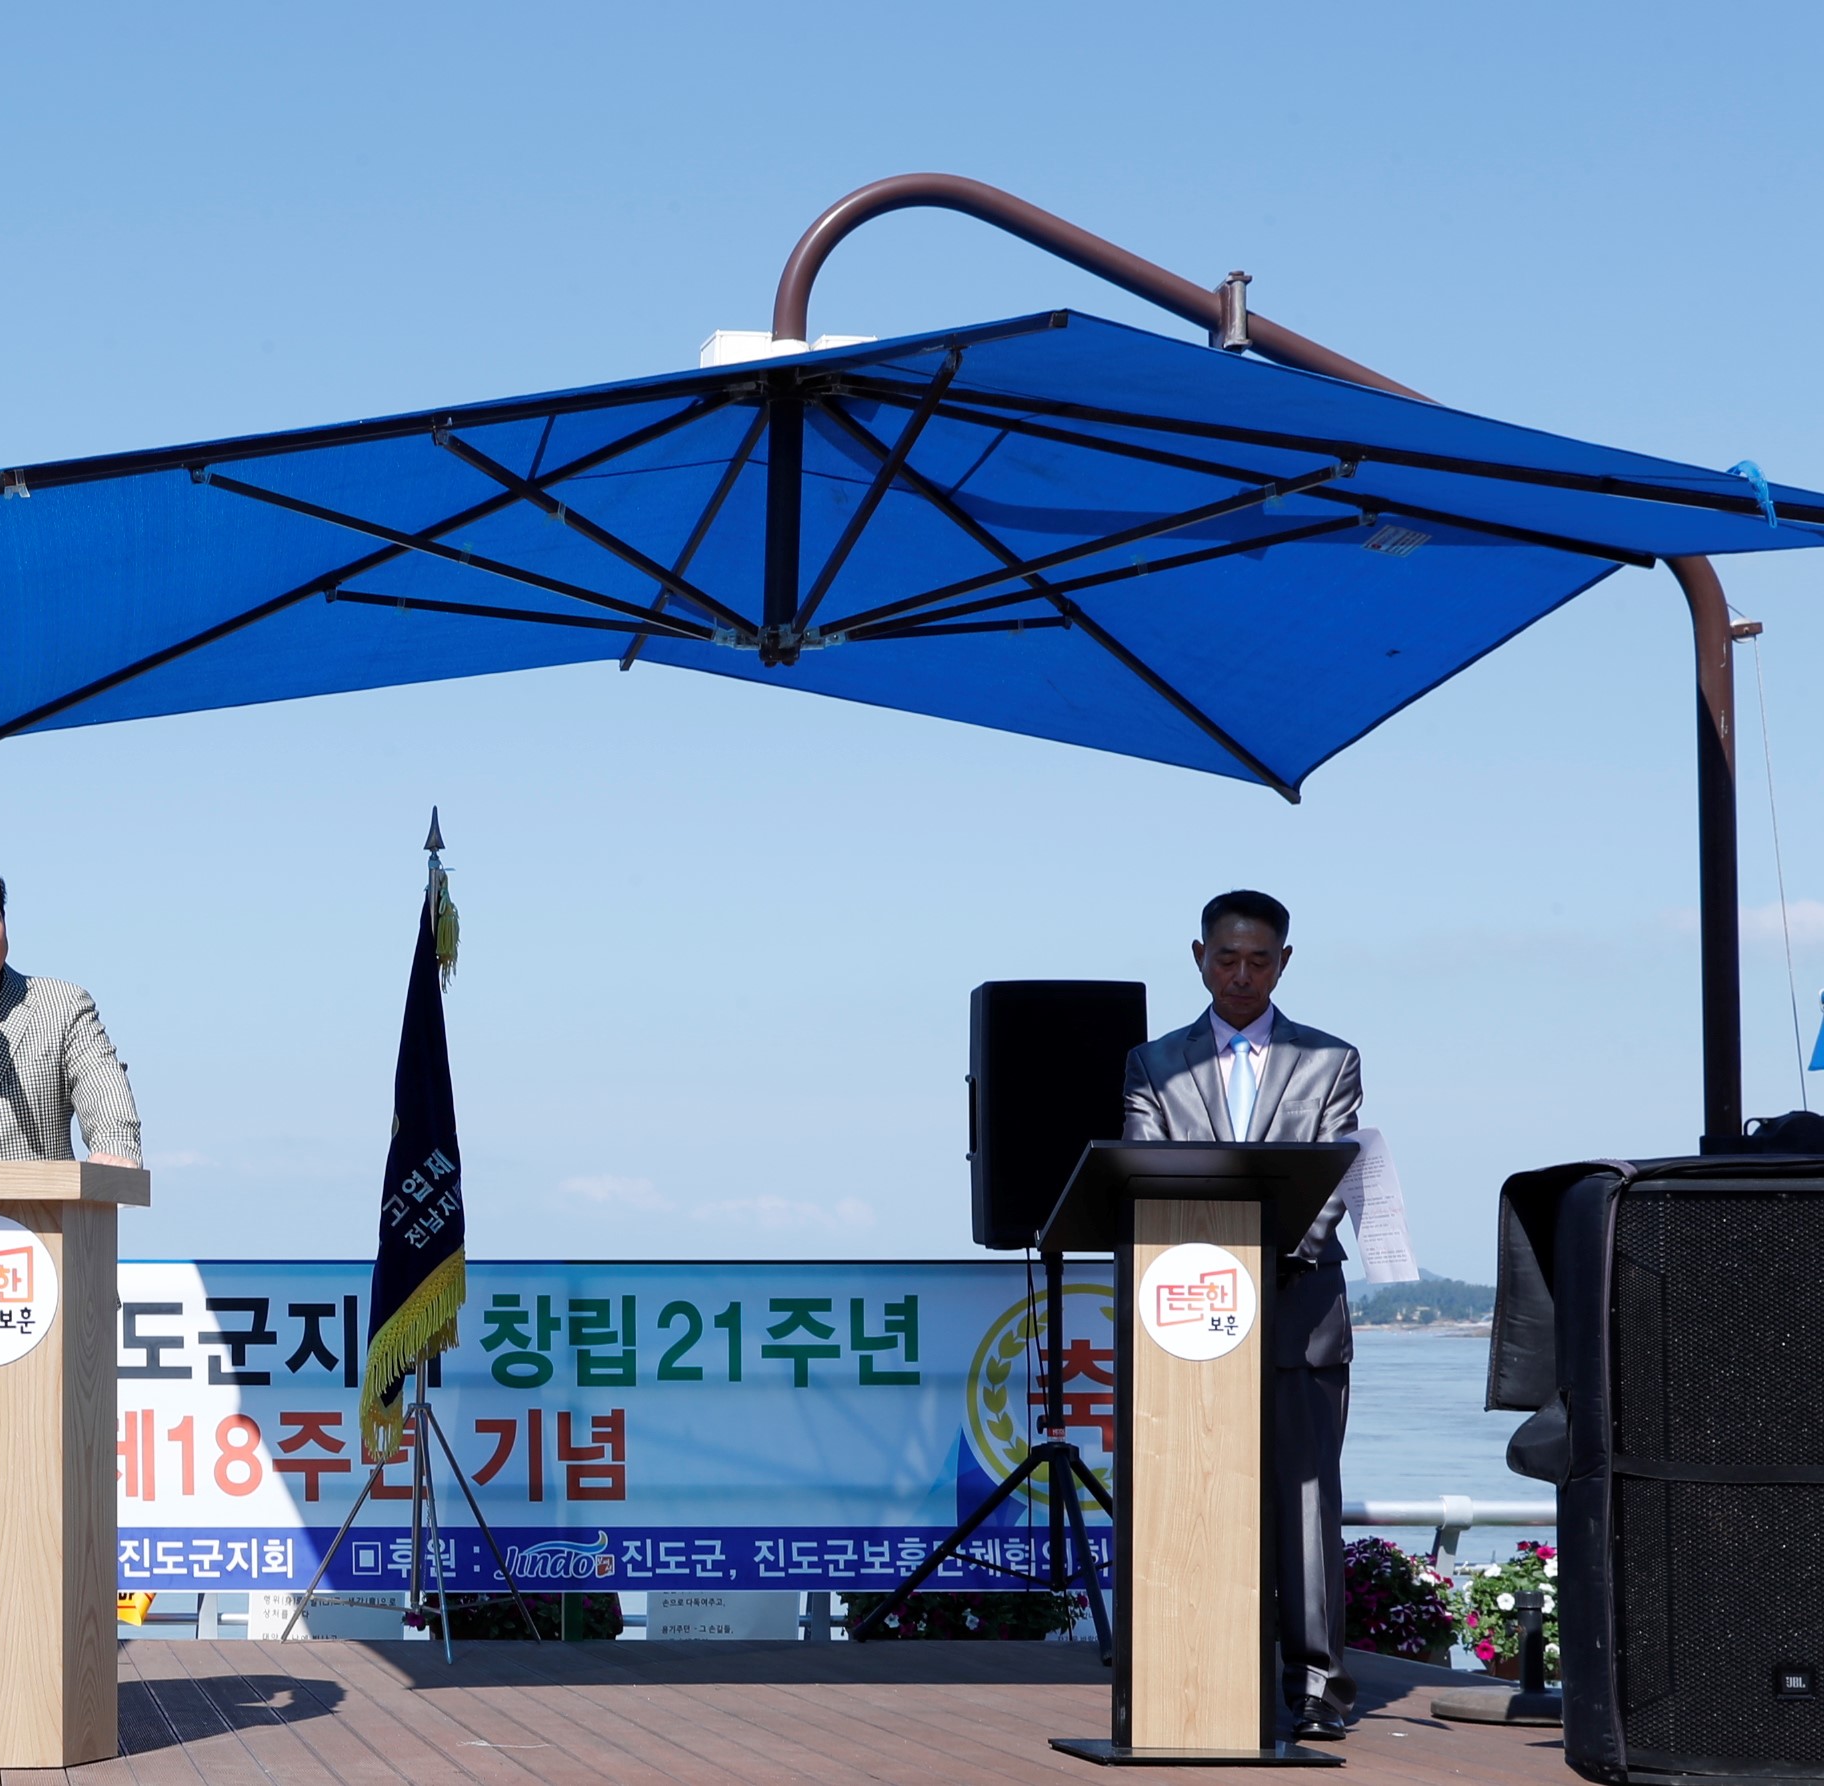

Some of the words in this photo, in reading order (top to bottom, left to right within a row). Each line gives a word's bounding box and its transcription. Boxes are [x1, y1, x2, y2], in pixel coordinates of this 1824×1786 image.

[382, 1148, 456, 1227] 고엽제
[117, 1295, 442, 1388] 도군지
[479, 1293, 921, 1389] 창립21주년
[1208, 1314, 1239, 1336] 보훈
[471, 1409, 626, 1502] 기념
[118, 1538, 294, 1579] 진도군지회
[387, 1538, 456, 1578] 후원
[494, 1545, 596, 1580] Jindo
[621, 1538, 737, 1580] 진도군,
[1785, 1676, 1806, 1688] JBL
